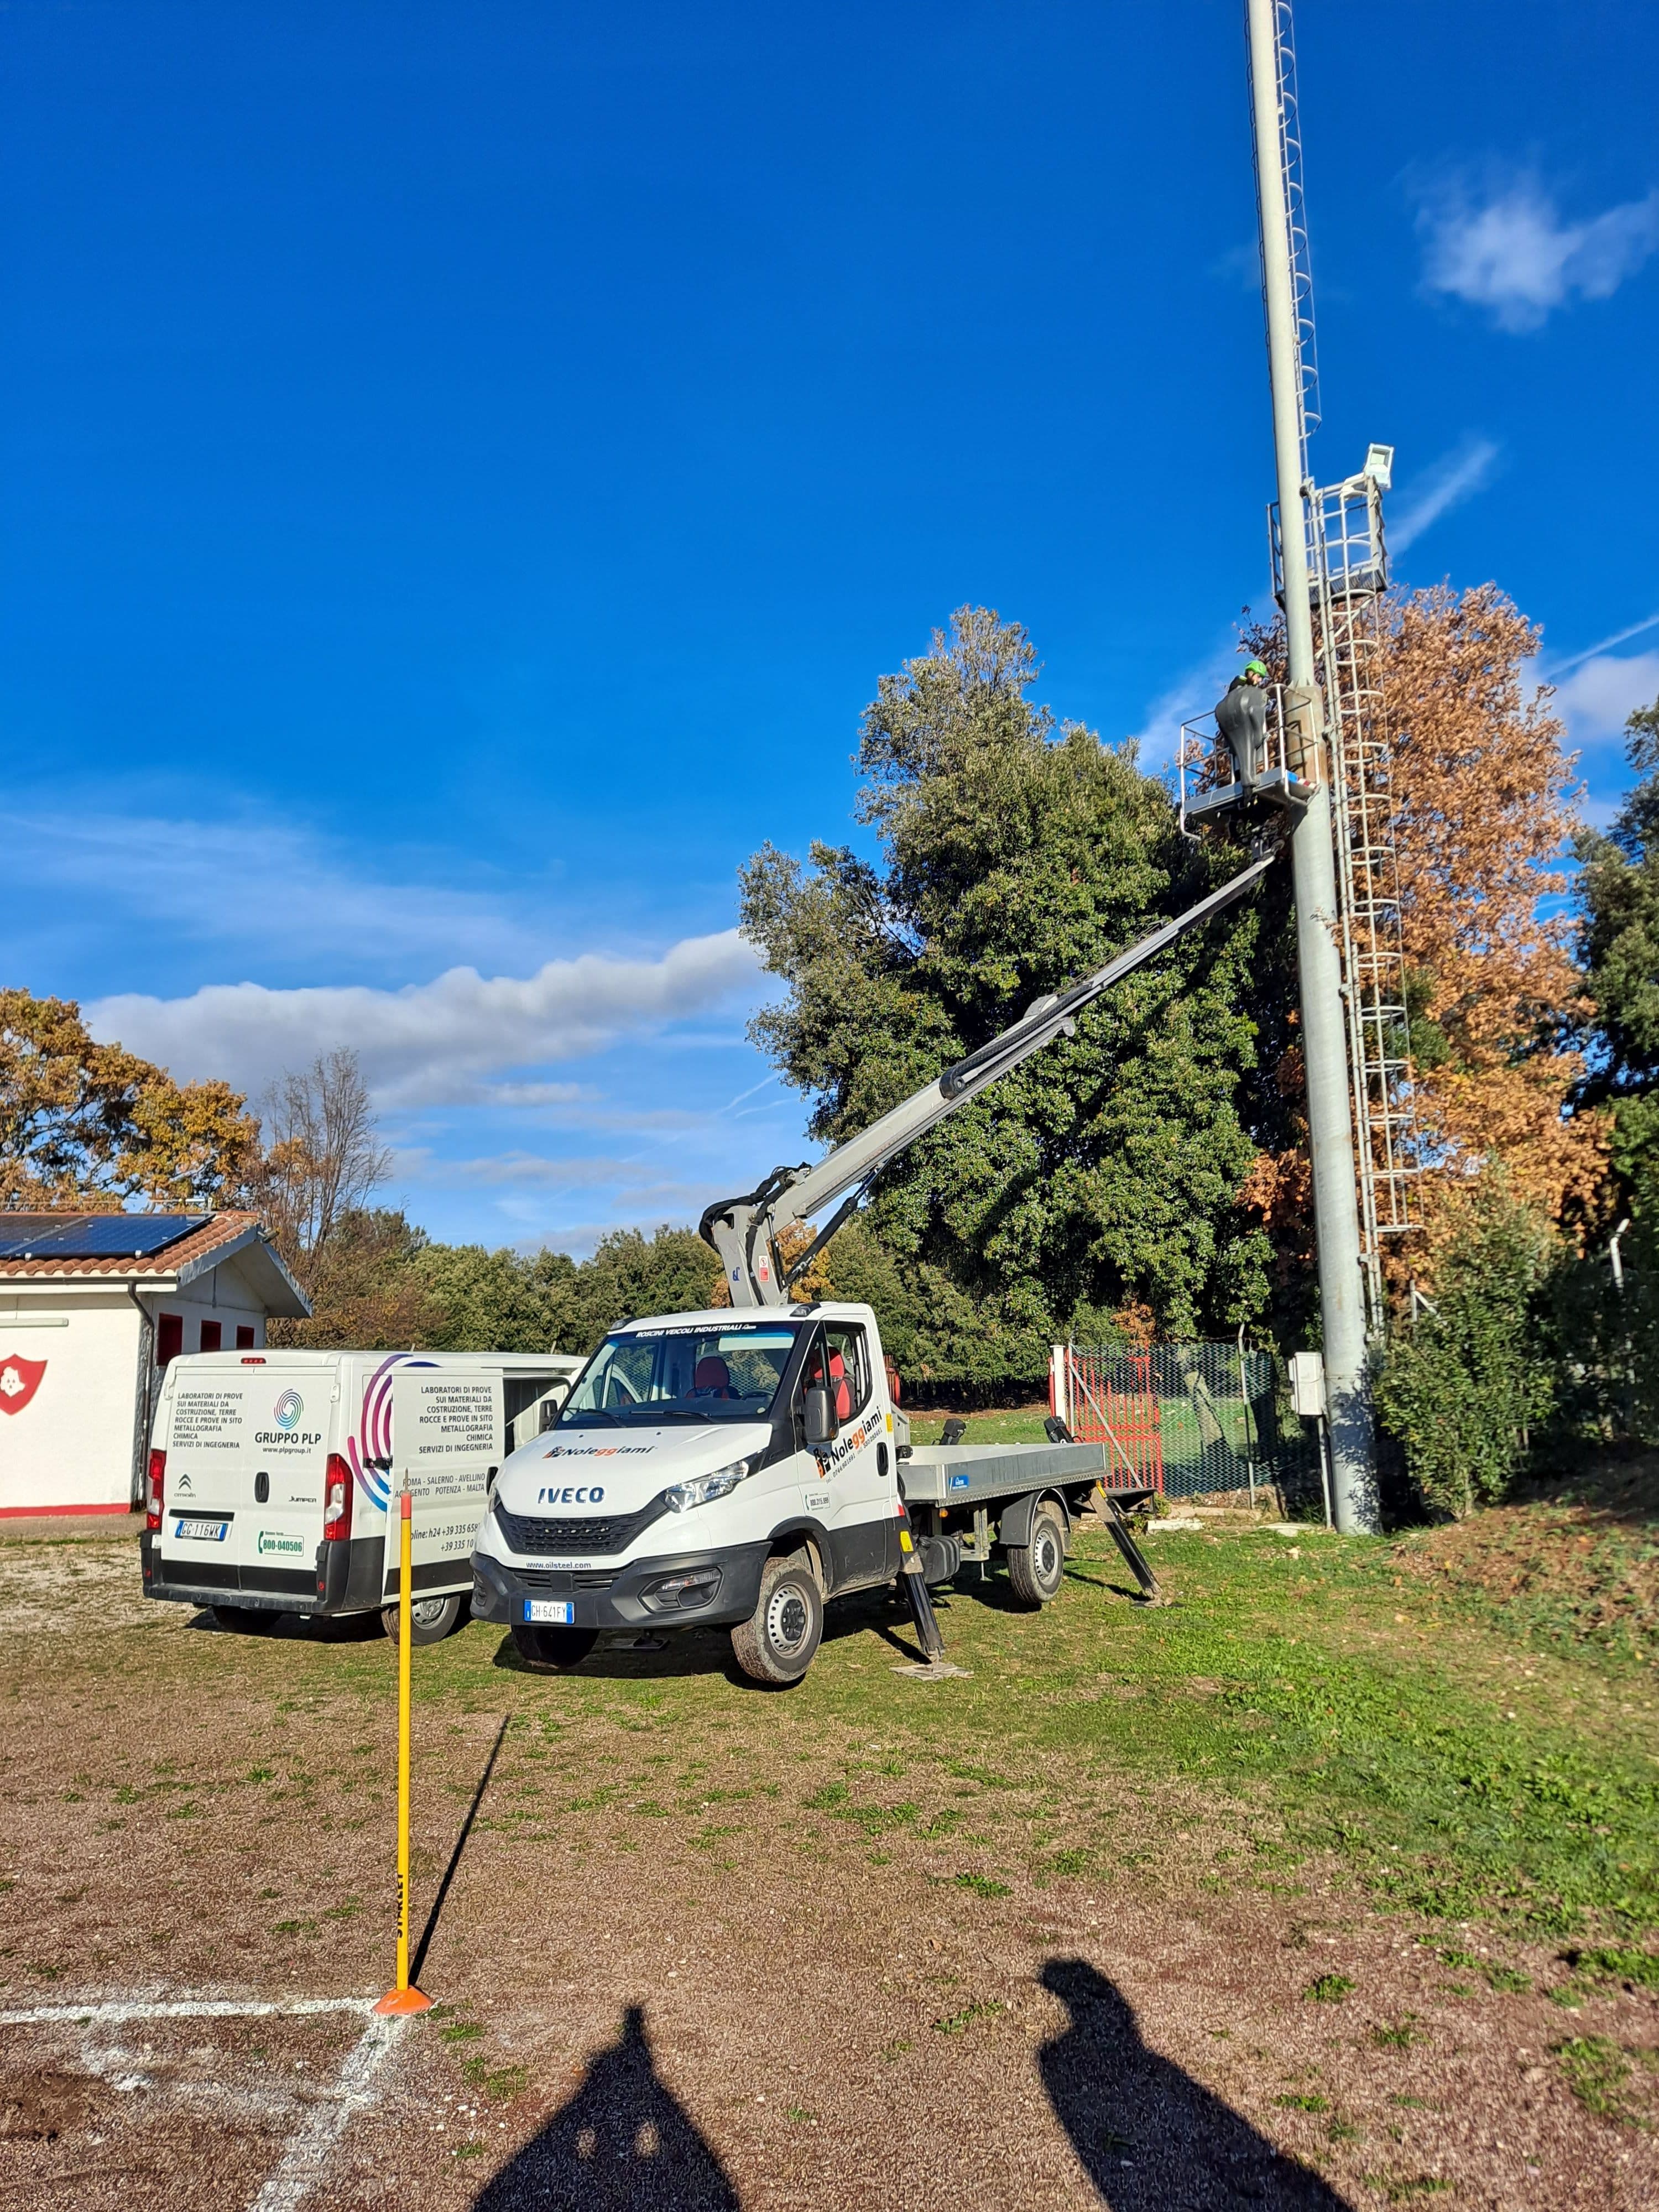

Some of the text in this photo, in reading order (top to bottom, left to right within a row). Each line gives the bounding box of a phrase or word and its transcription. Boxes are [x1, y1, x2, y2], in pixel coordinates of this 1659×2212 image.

[694, 1324, 743, 1333] INDUSTRIALI
[427, 1405, 473, 1413] COSTRUZIONE,
[441, 1424, 493, 1433] METALLOGRAFIA
[255, 1432, 321, 1444] GRUPPO PLP
[830, 1406, 883, 1465] Noleggiami
[455, 1443, 493, 1452] INGEGNERIA
[562, 1446, 655, 1457] Noleggiami
[427, 1475, 453, 1485] SALERNO
[458, 1473, 485, 1483] AVELLINO
[435, 1486, 461, 1495] POTENZA
[467, 1484, 484, 1492] MALTA
[538, 1486, 605, 1504] IVECO
[429, 1527, 441, 1538] h24
[442, 1526, 453, 1536] +39
[455, 1524, 466, 1535] 335
[263, 1539, 302, 1552] 800-040506
[441, 1541, 453, 1552] +39
[454, 1540, 465, 1550] 335
